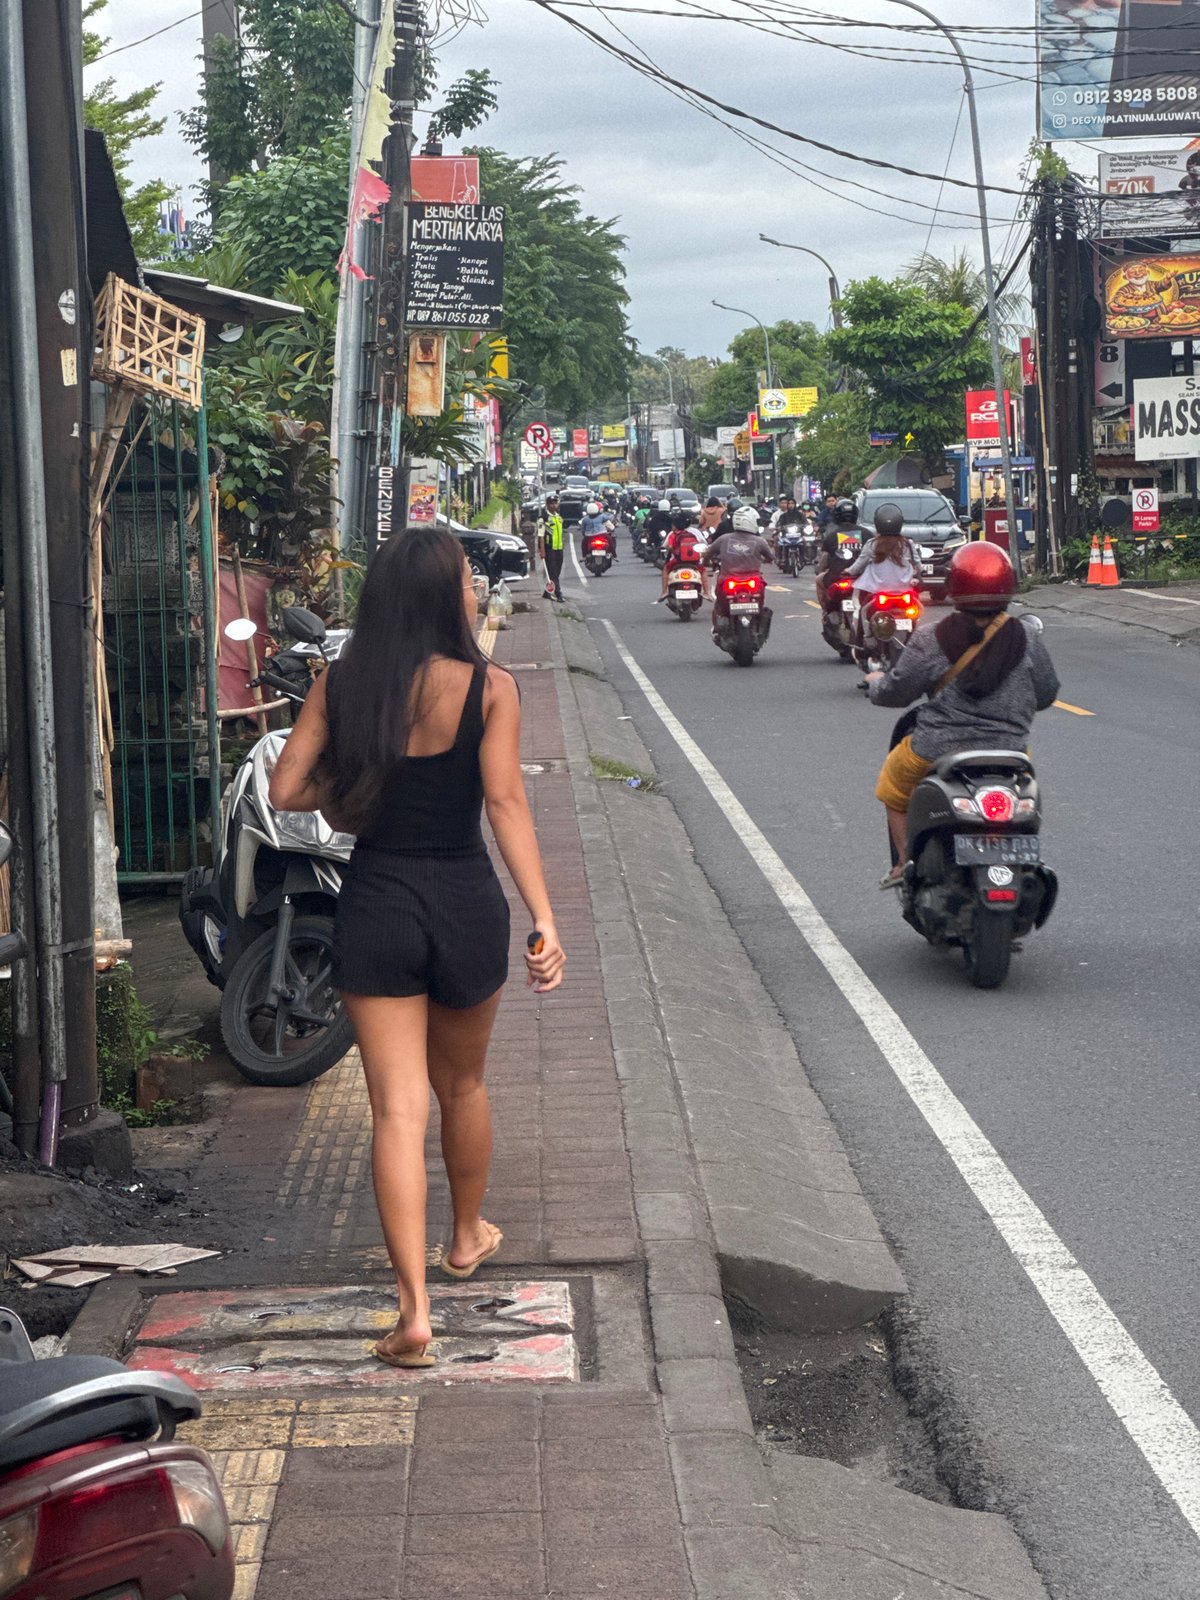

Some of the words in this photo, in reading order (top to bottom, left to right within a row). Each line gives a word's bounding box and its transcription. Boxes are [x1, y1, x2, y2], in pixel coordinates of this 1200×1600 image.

[1074, 91, 1109, 105] 0812
[1113, 88, 1152, 103] 3928
[1156, 86, 1198, 101] 5808
[1118, 180, 1150, 194] 70K
[424, 204, 479, 220] BENGKEL
[481, 205, 504, 221] LAS
[412, 219, 463, 240] MERTHA
[465, 220, 503, 242] KARYA
[431, 311, 446, 322] 861
[447, 312, 467, 322] 055
[376, 466, 394, 541] BENGKEL
